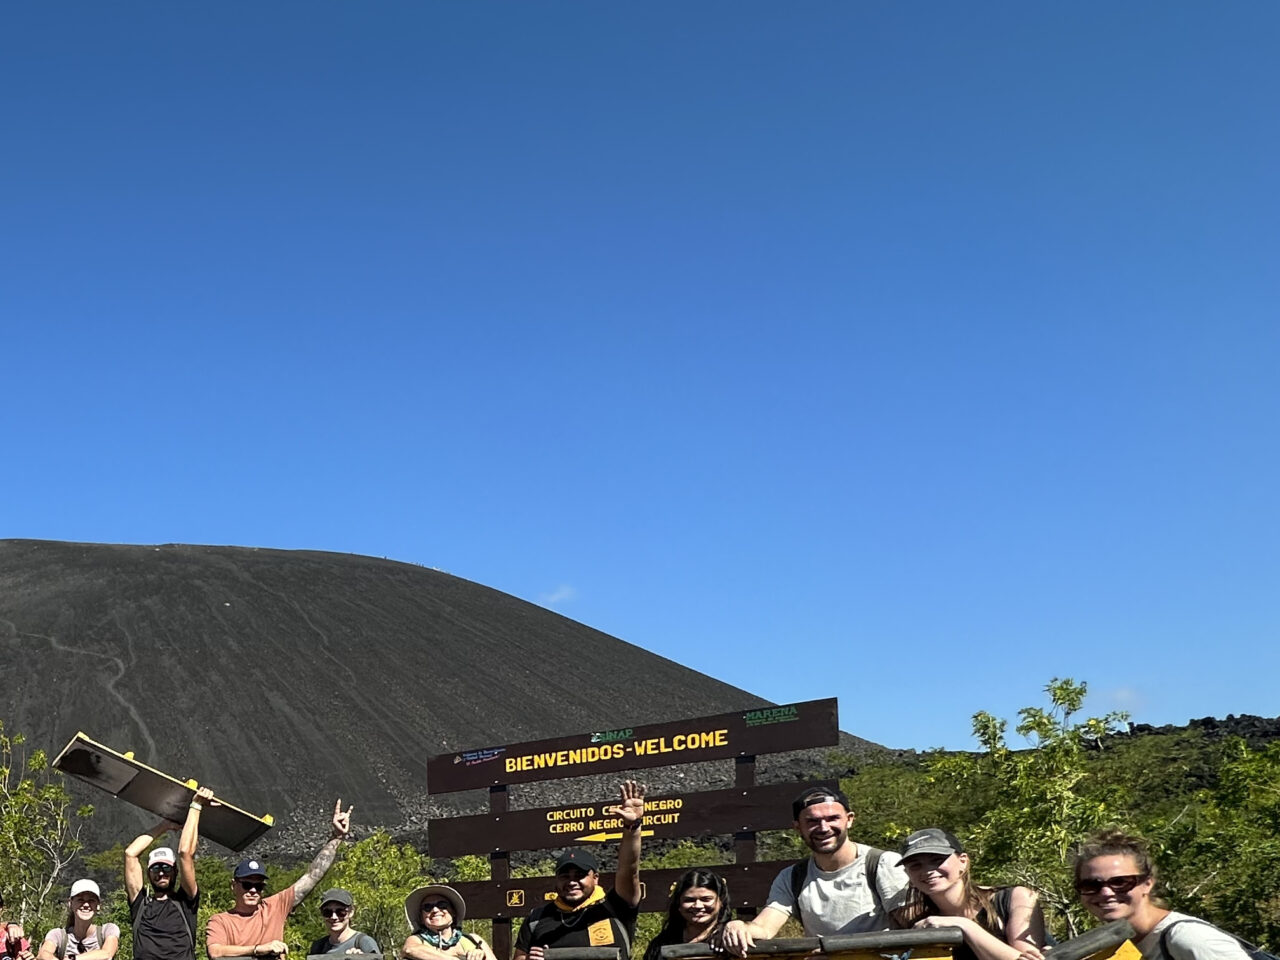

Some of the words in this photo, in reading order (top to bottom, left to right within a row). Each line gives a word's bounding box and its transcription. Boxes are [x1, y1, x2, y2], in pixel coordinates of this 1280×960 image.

[546, 807, 594, 821] CIRCUITO
[644, 799, 683, 812] NEGRO
[549, 821, 585, 834] CERRO
[640, 813, 680, 826] IRCUIT
